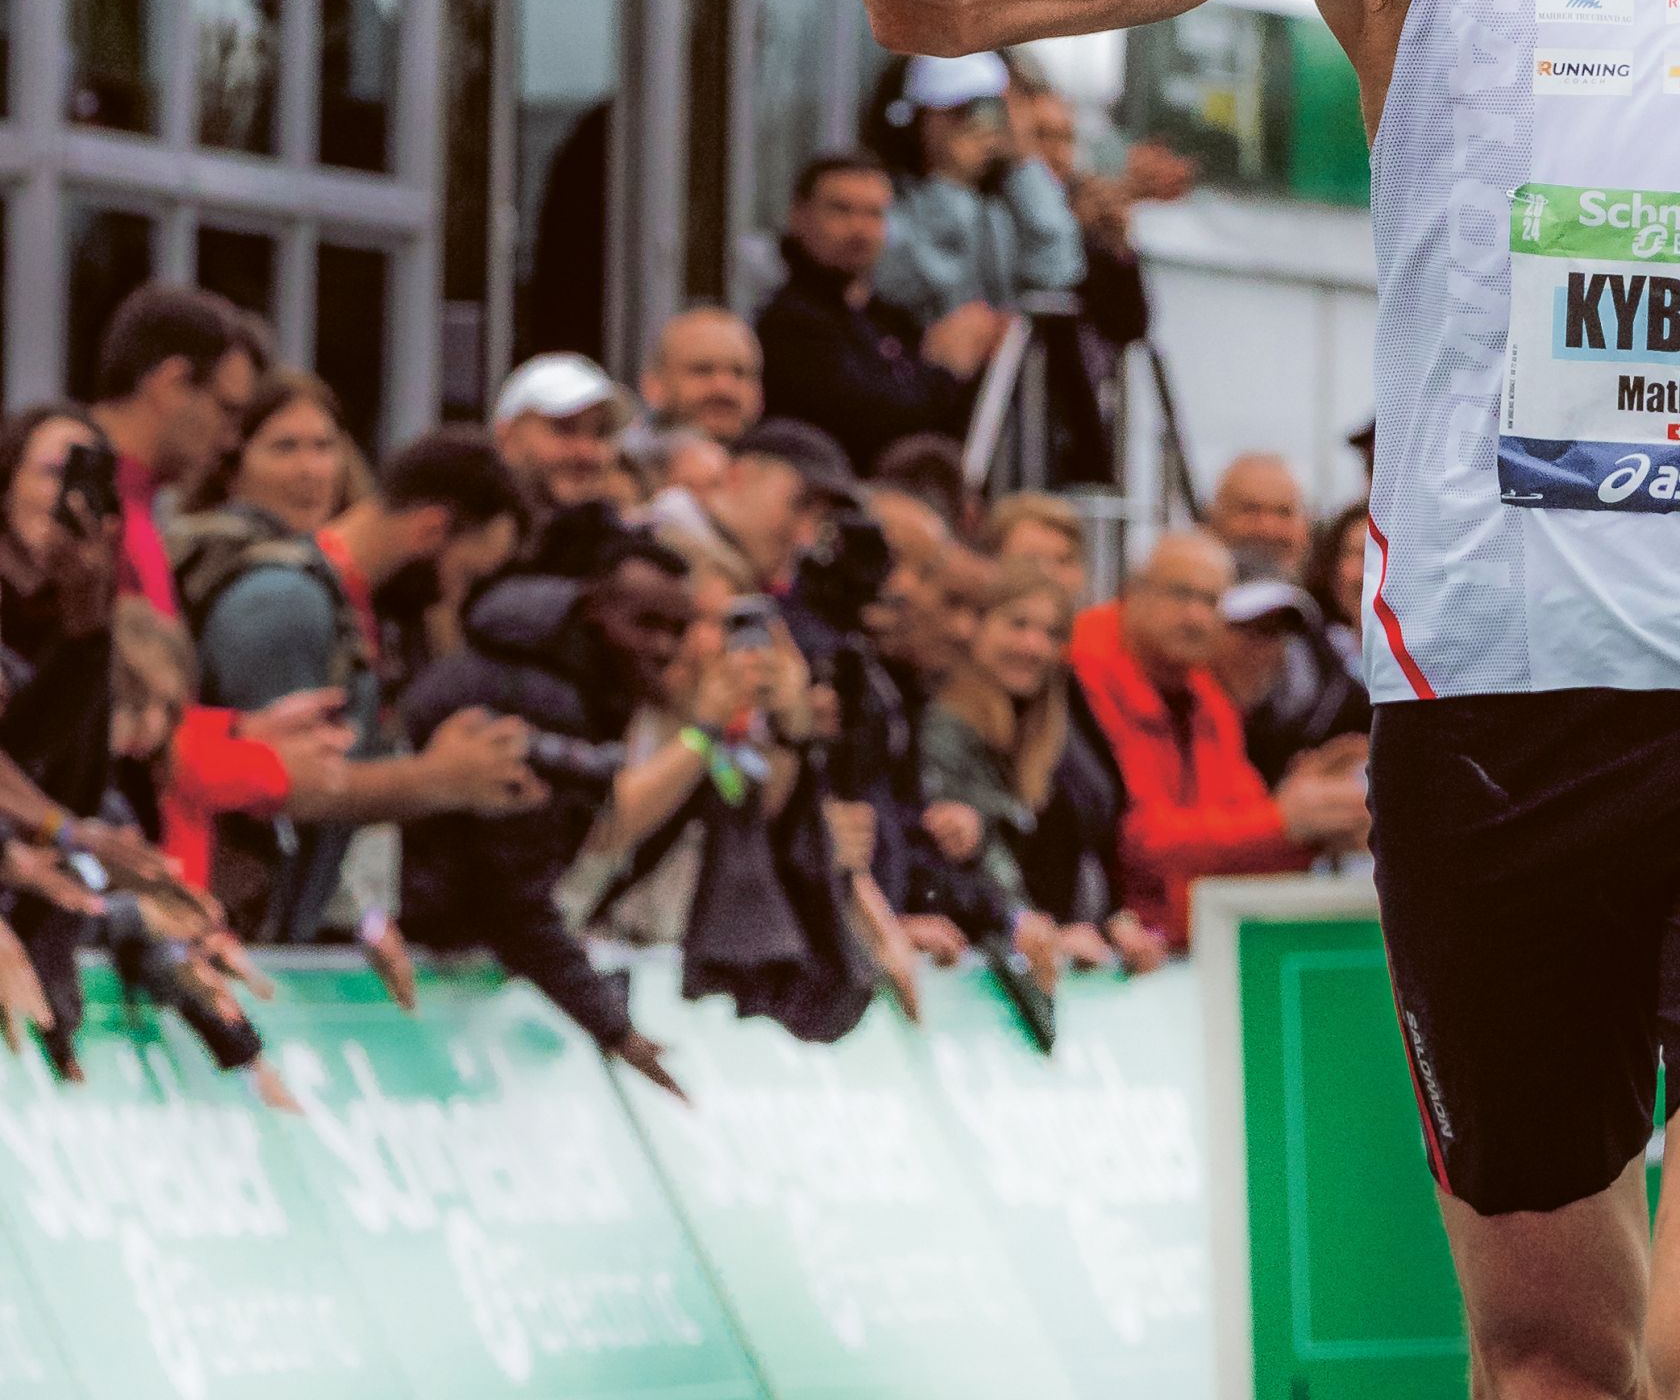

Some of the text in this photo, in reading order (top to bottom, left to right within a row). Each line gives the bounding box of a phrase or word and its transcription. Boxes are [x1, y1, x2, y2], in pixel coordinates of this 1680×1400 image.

[1537, 61, 1631, 77] RUNNING
[1522, 217, 1541, 242] 24
[1404, 1010, 1453, 1139] SALOMON
